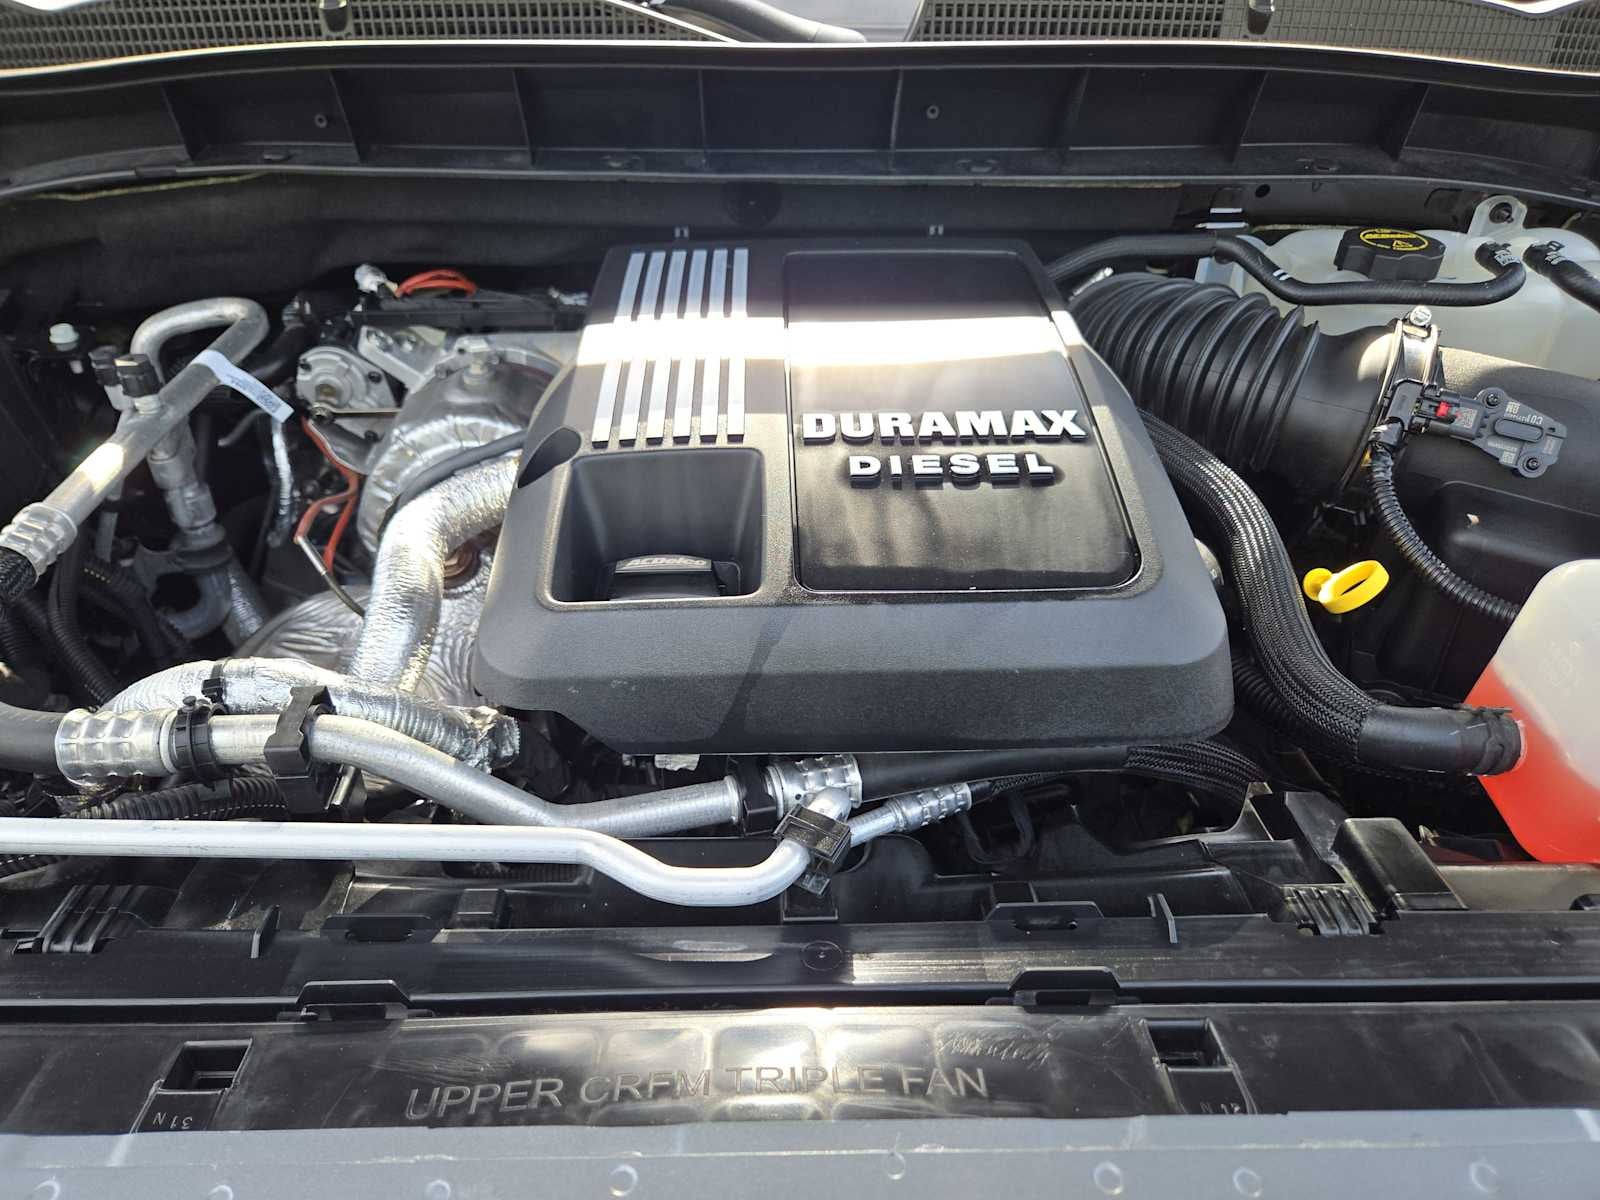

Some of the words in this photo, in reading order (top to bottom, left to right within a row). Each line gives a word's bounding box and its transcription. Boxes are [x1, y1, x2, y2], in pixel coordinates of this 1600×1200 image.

[803, 410, 1088, 443] DURAMAX
[849, 453, 1055, 479] DIESEL
[621, 557, 706, 569] ACDelco
[405, 1078, 563, 1120] UPPER
[579, 1070, 711, 1105] CRFM
[724, 1064, 886, 1096] TRIPLE
[900, 1066, 989, 1098] FAN
